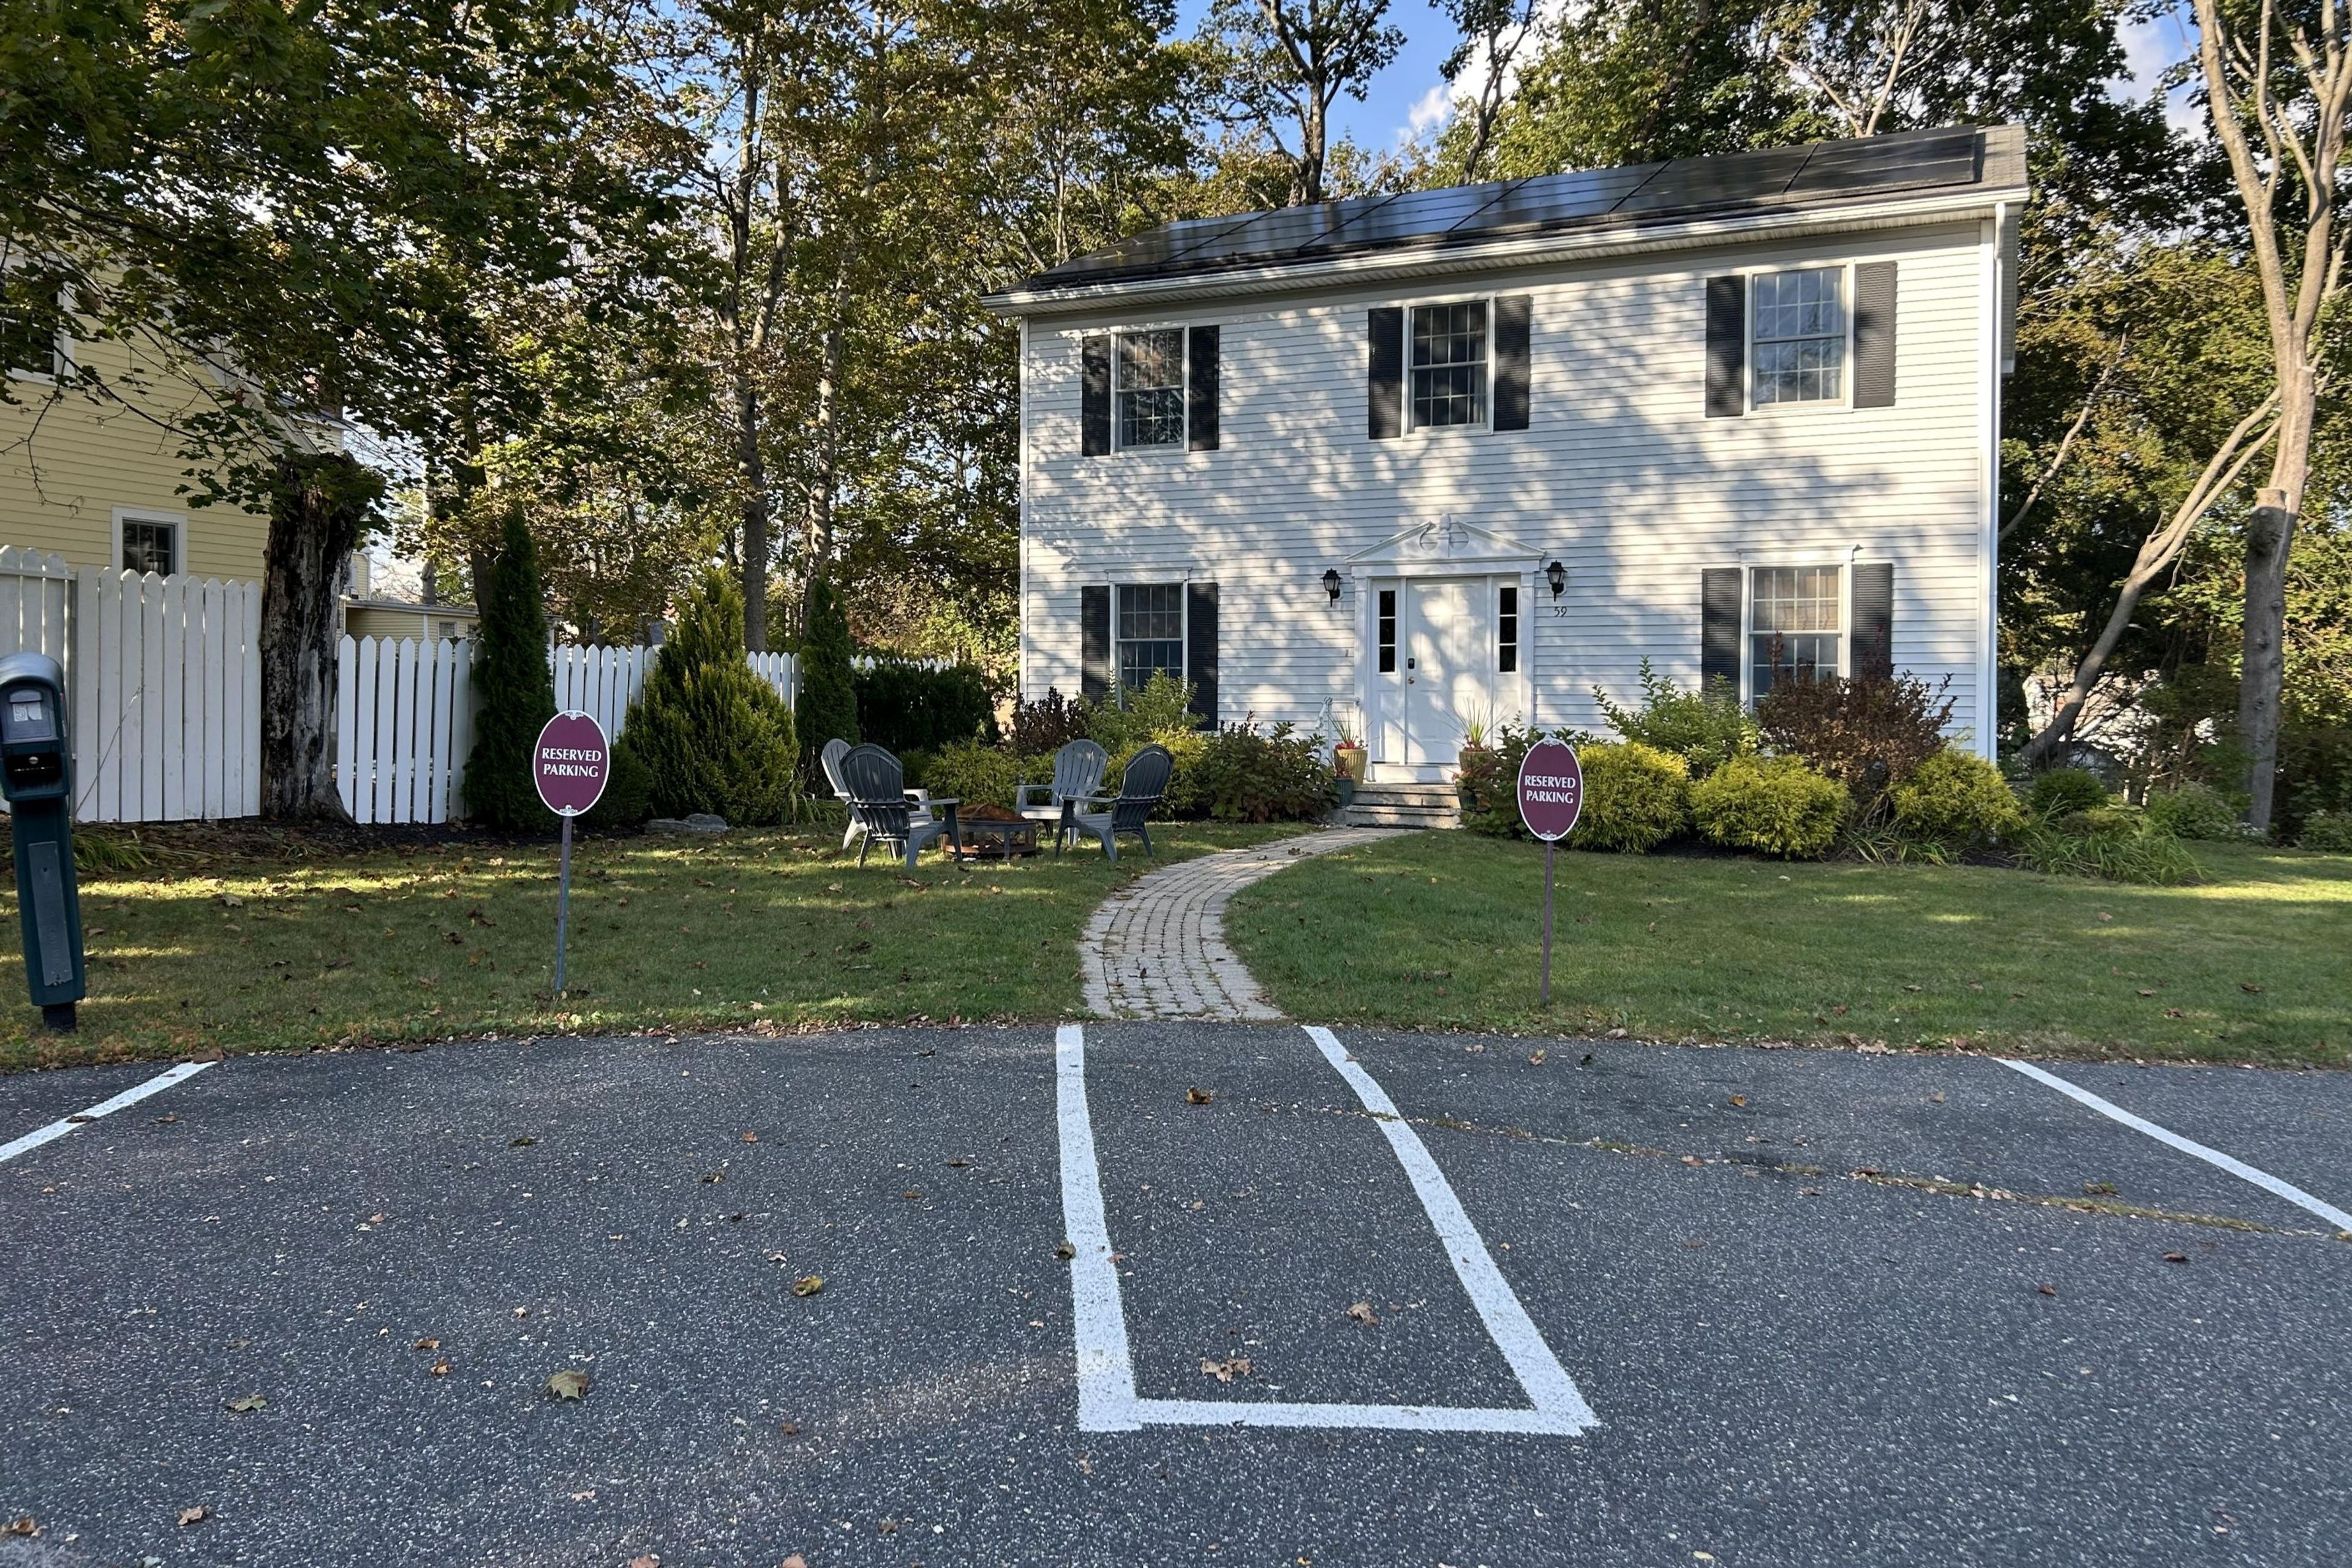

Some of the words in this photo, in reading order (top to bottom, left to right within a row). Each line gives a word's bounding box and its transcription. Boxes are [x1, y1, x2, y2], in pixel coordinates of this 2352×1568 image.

[1554, 606, 1567, 617] 59
[541, 748, 601, 762] RESERVED
[543, 764, 598, 777] PARKING
[1525, 775, 1576, 788] RESERVED
[1526, 790, 1574, 804] PARKING
